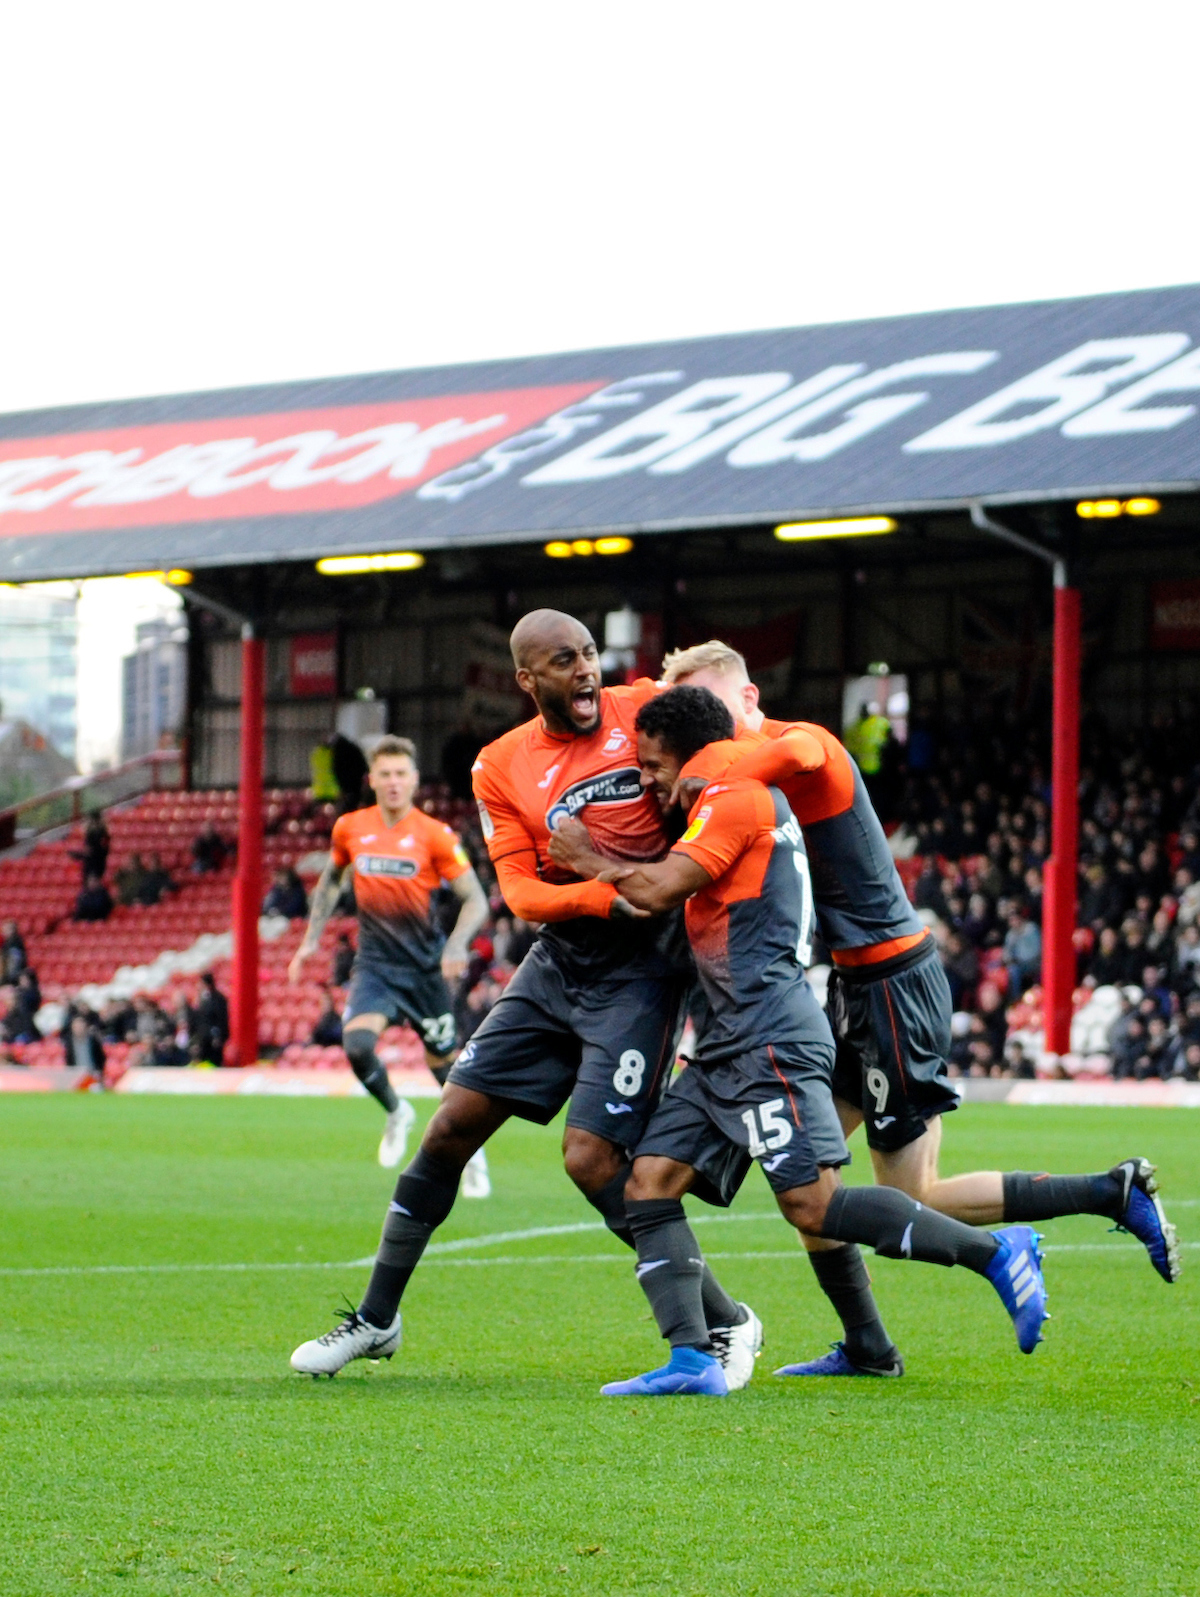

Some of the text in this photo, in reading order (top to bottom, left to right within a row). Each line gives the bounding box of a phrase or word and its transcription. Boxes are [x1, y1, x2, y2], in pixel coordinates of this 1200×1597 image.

[520, 348, 999, 488] BIG
[613, 1048, 646, 1097] 8
[866, 1067, 890, 1113] 9
[741, 1097, 793, 1158] 15
